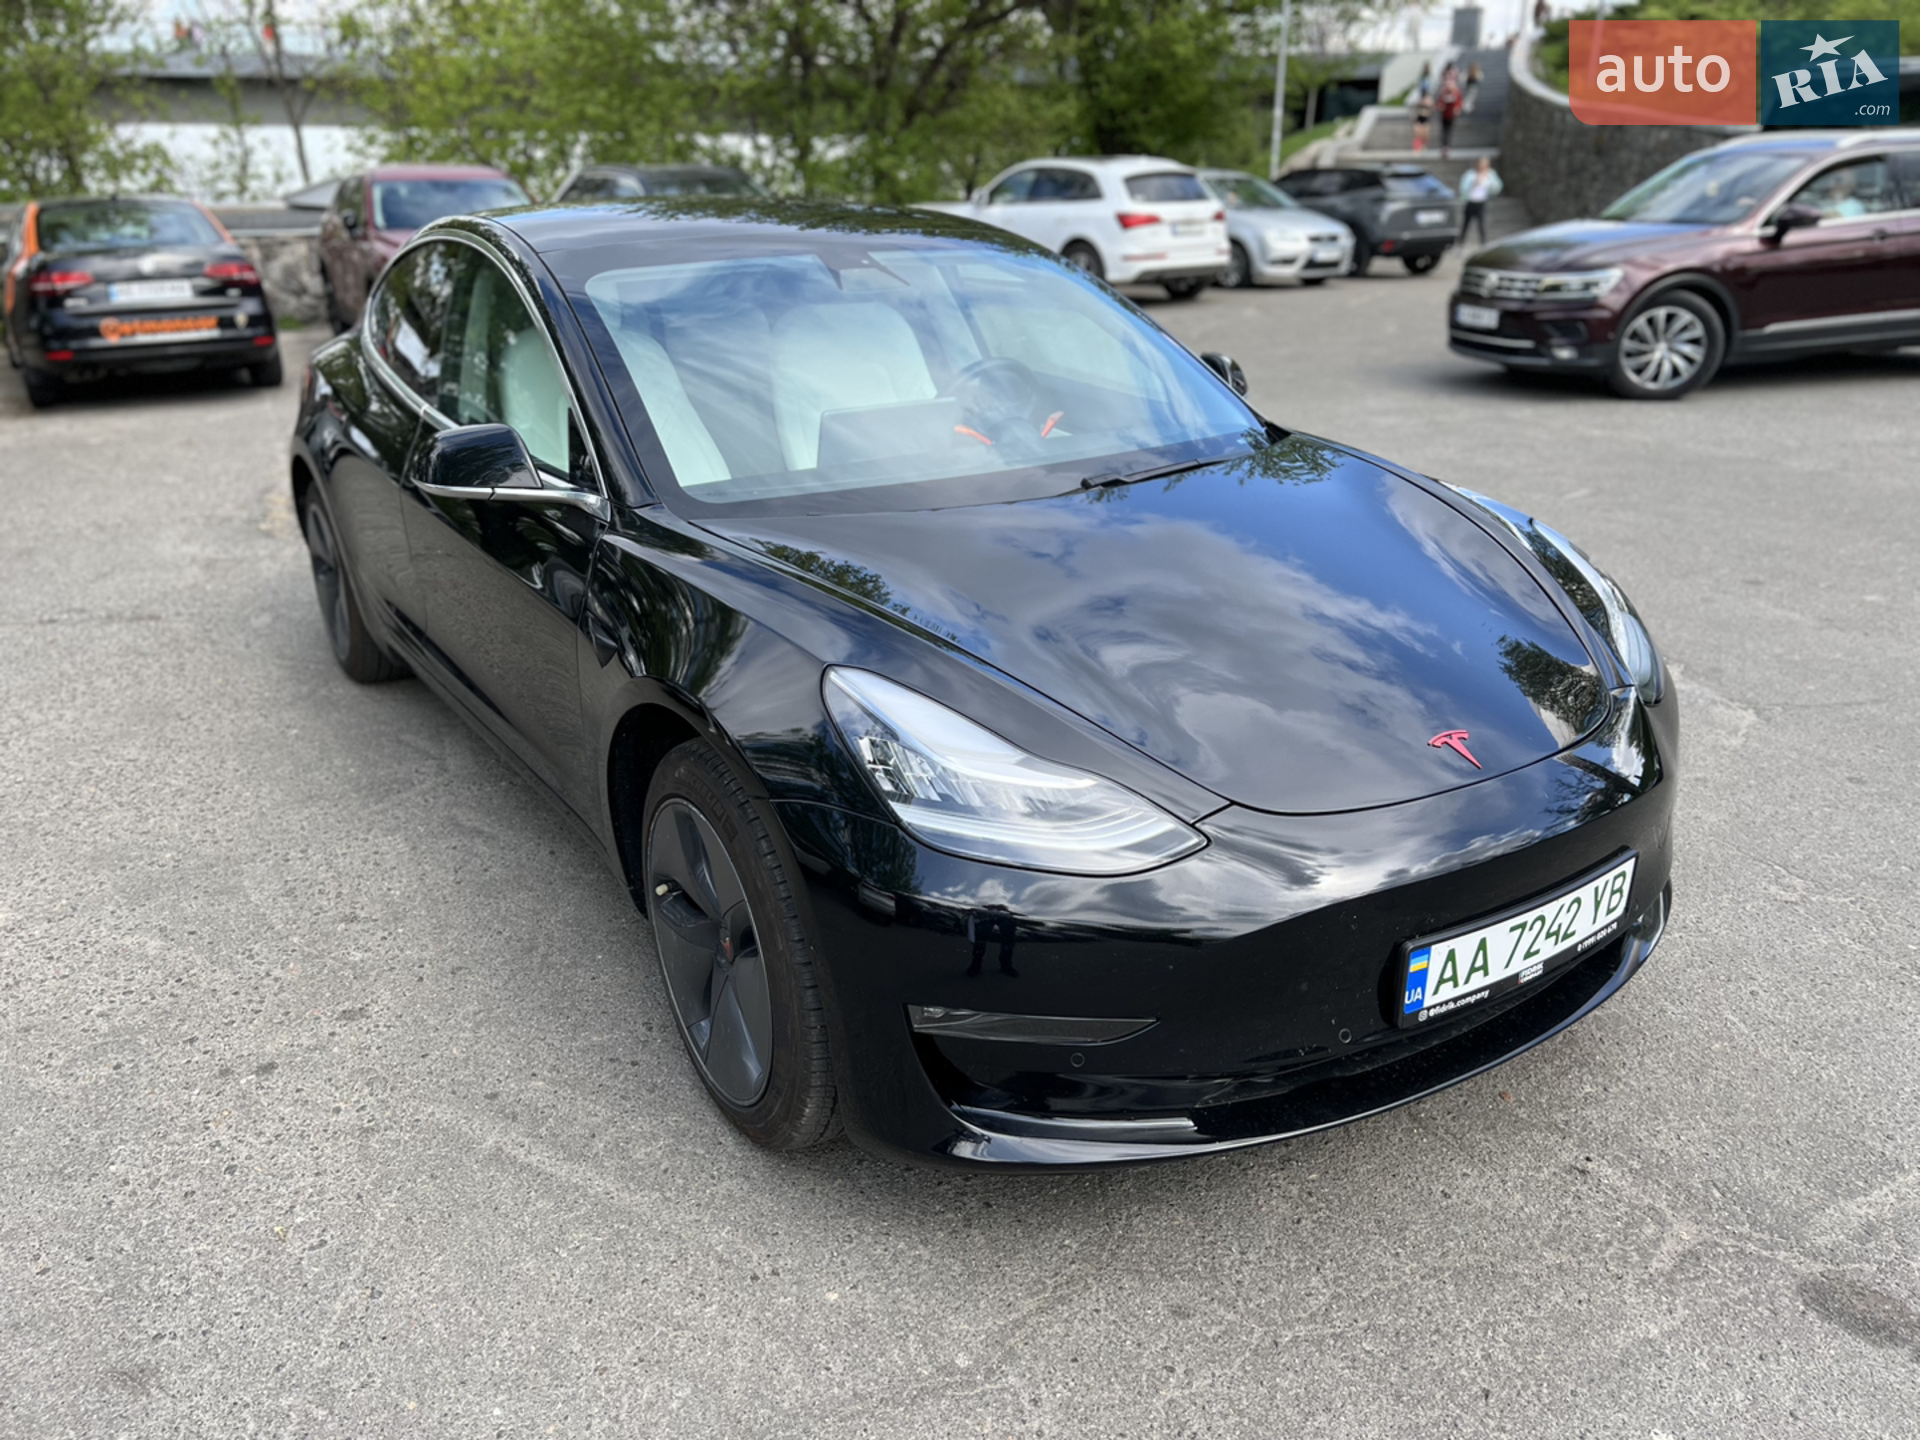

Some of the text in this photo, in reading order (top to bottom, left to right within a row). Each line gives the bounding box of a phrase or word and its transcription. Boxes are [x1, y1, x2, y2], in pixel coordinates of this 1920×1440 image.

[1432, 937, 1489, 996] AA
[1504, 896, 1582, 969] 7242
[1592, 870, 1627, 925] YB
[1405, 987, 1422, 1004] UA
